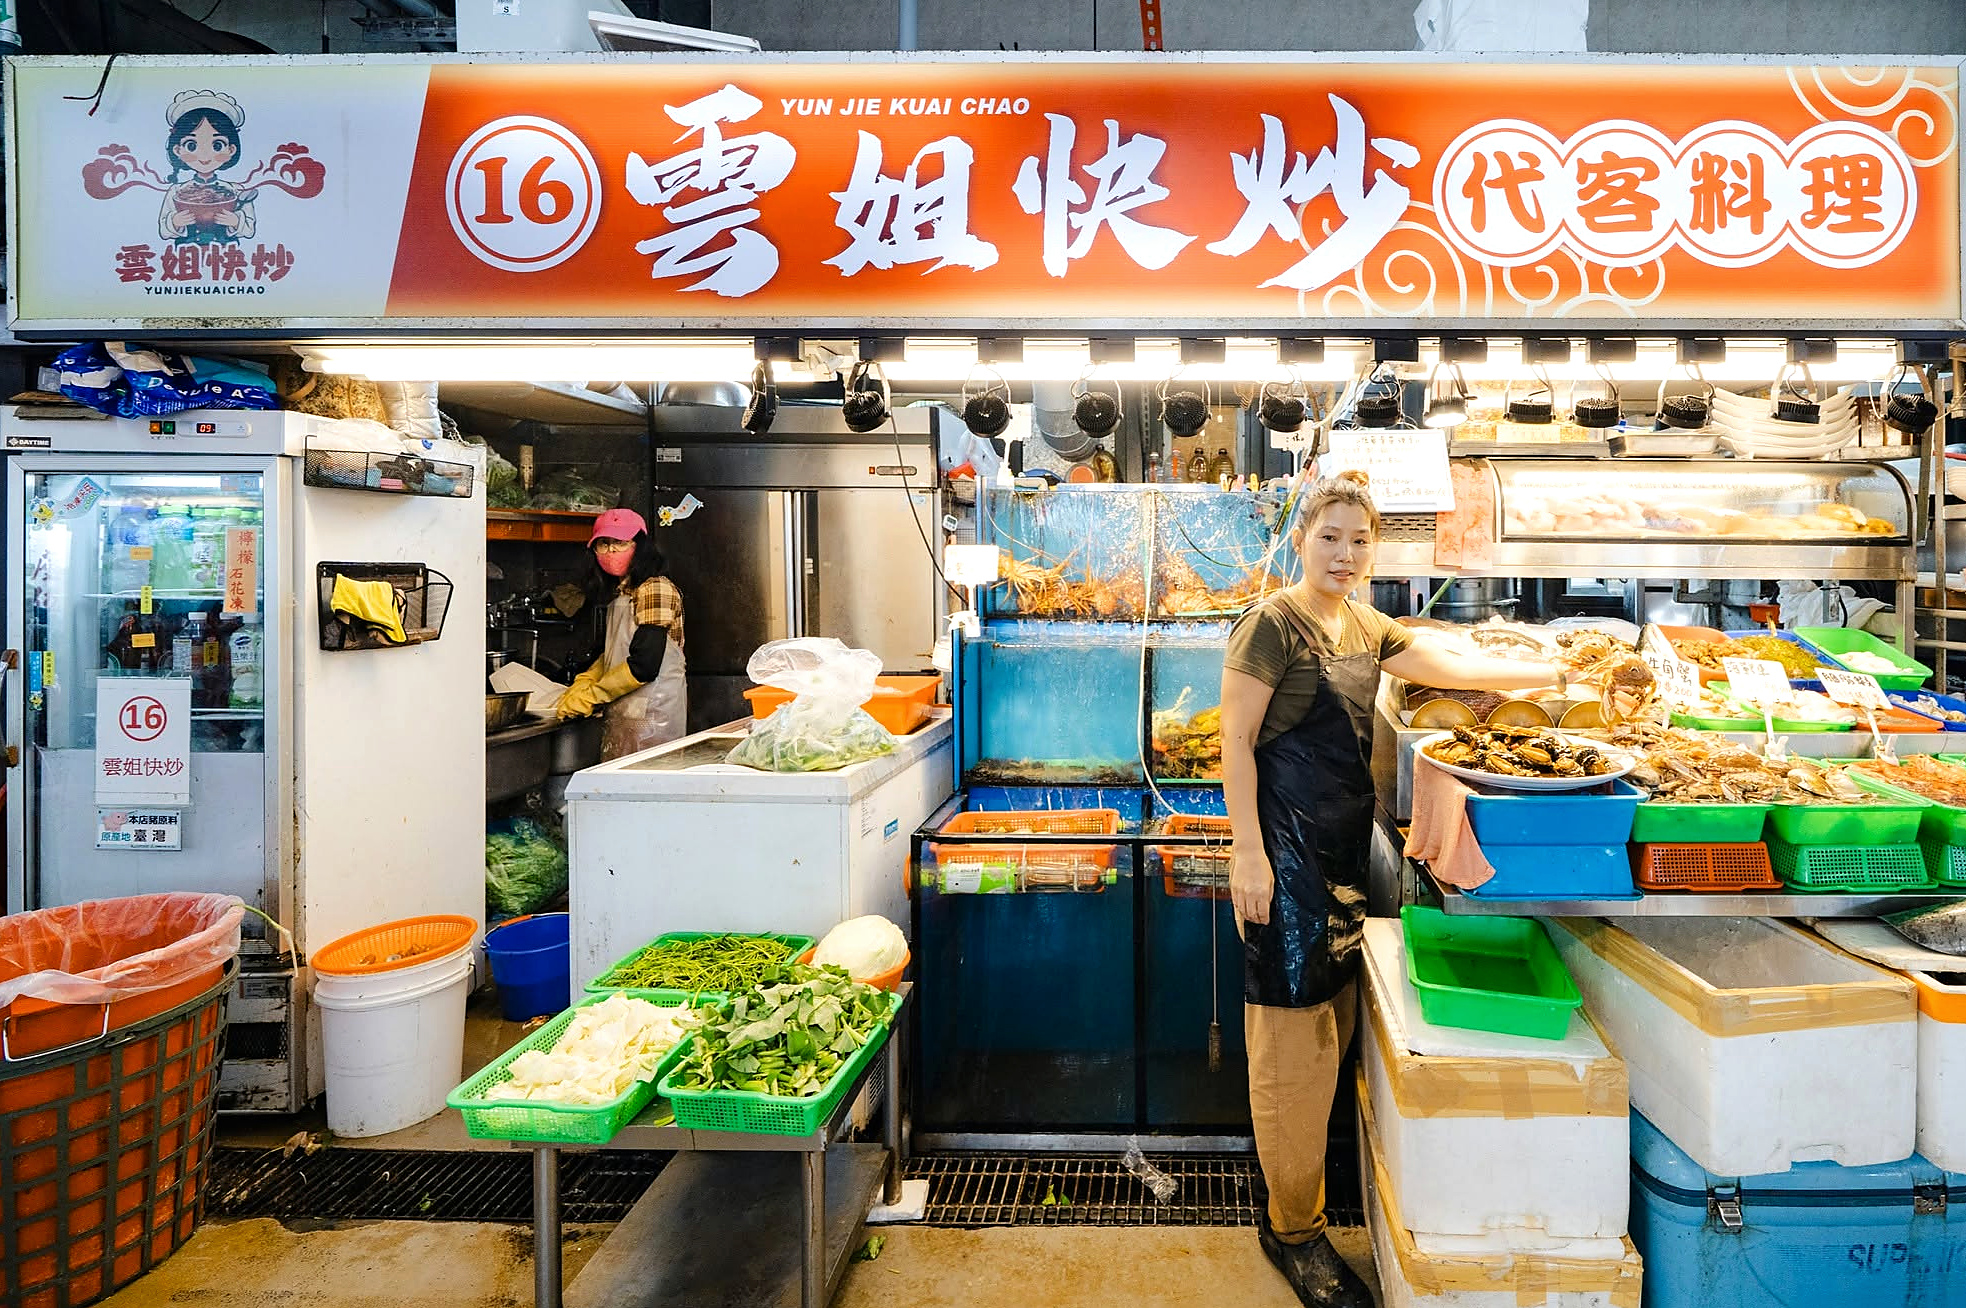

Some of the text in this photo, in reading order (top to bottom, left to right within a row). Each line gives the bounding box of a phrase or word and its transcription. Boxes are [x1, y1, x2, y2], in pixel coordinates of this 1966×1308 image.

[780, 97, 1030, 115] YUN JIE KUAI CHAO
[473, 156, 575, 225] 16
[625, 84, 1421, 297] 雲姐快炒
[1462, 151, 1885, 235] 代客料理
[115, 243, 295, 282] 雲姐快炒
[144, 286, 266, 295] YUNJIEKUAICHAO
[125, 704, 163, 729] 16
[102, 757, 184, 777] 雲姐快炒
[128, 815, 178, 825] 本店豬原料
